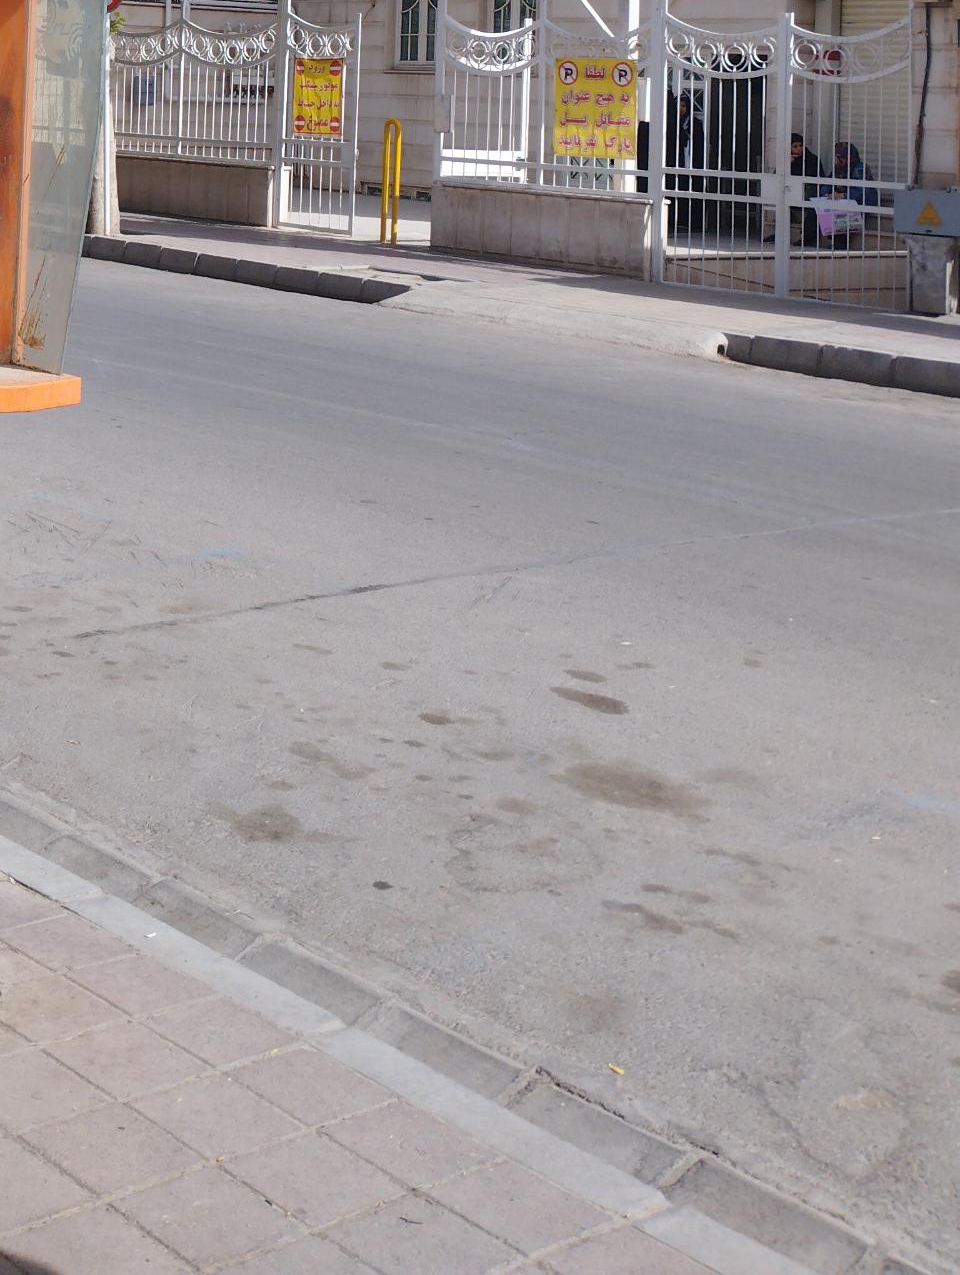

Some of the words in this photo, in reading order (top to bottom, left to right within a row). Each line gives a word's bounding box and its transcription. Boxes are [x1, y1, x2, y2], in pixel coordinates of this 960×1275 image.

[308, 65, 325, 74] ورود
[585, 65, 606, 79] لطفا
[562, 89, 591, 106] عنوان
[595, 93, 615, 107] هیچ
